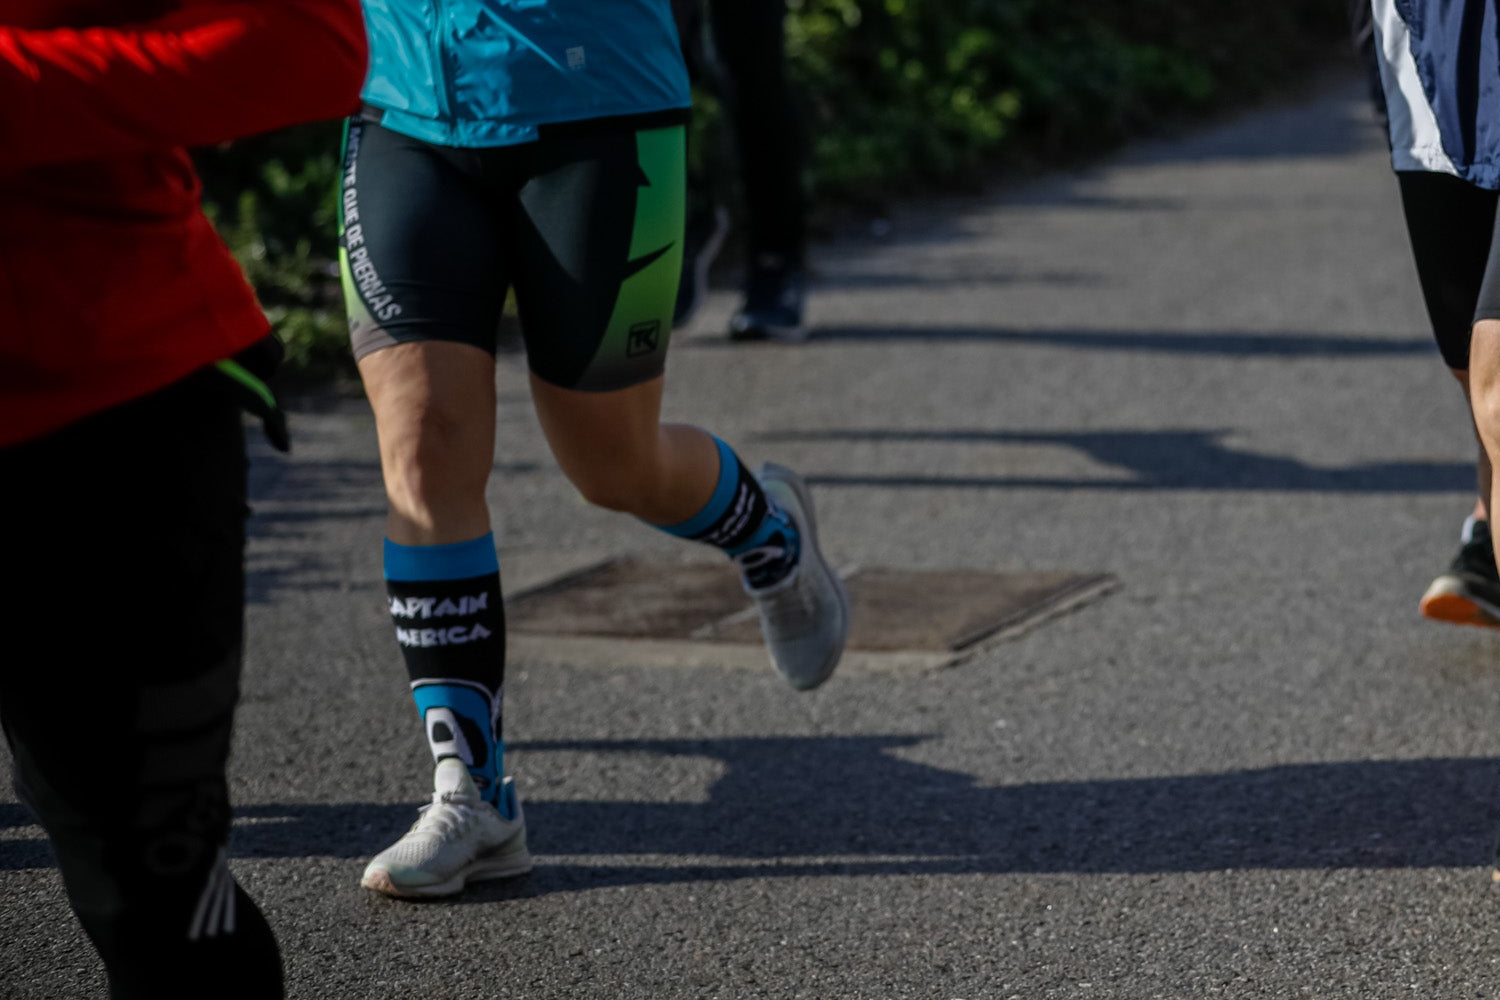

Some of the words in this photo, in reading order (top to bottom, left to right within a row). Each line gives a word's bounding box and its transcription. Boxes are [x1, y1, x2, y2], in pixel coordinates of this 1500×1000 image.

[343, 187, 360, 227] QUE
[346, 223, 365, 251] DE
[350, 246, 403, 321] PIERNAS
[396, 623, 491, 648] MERICA
